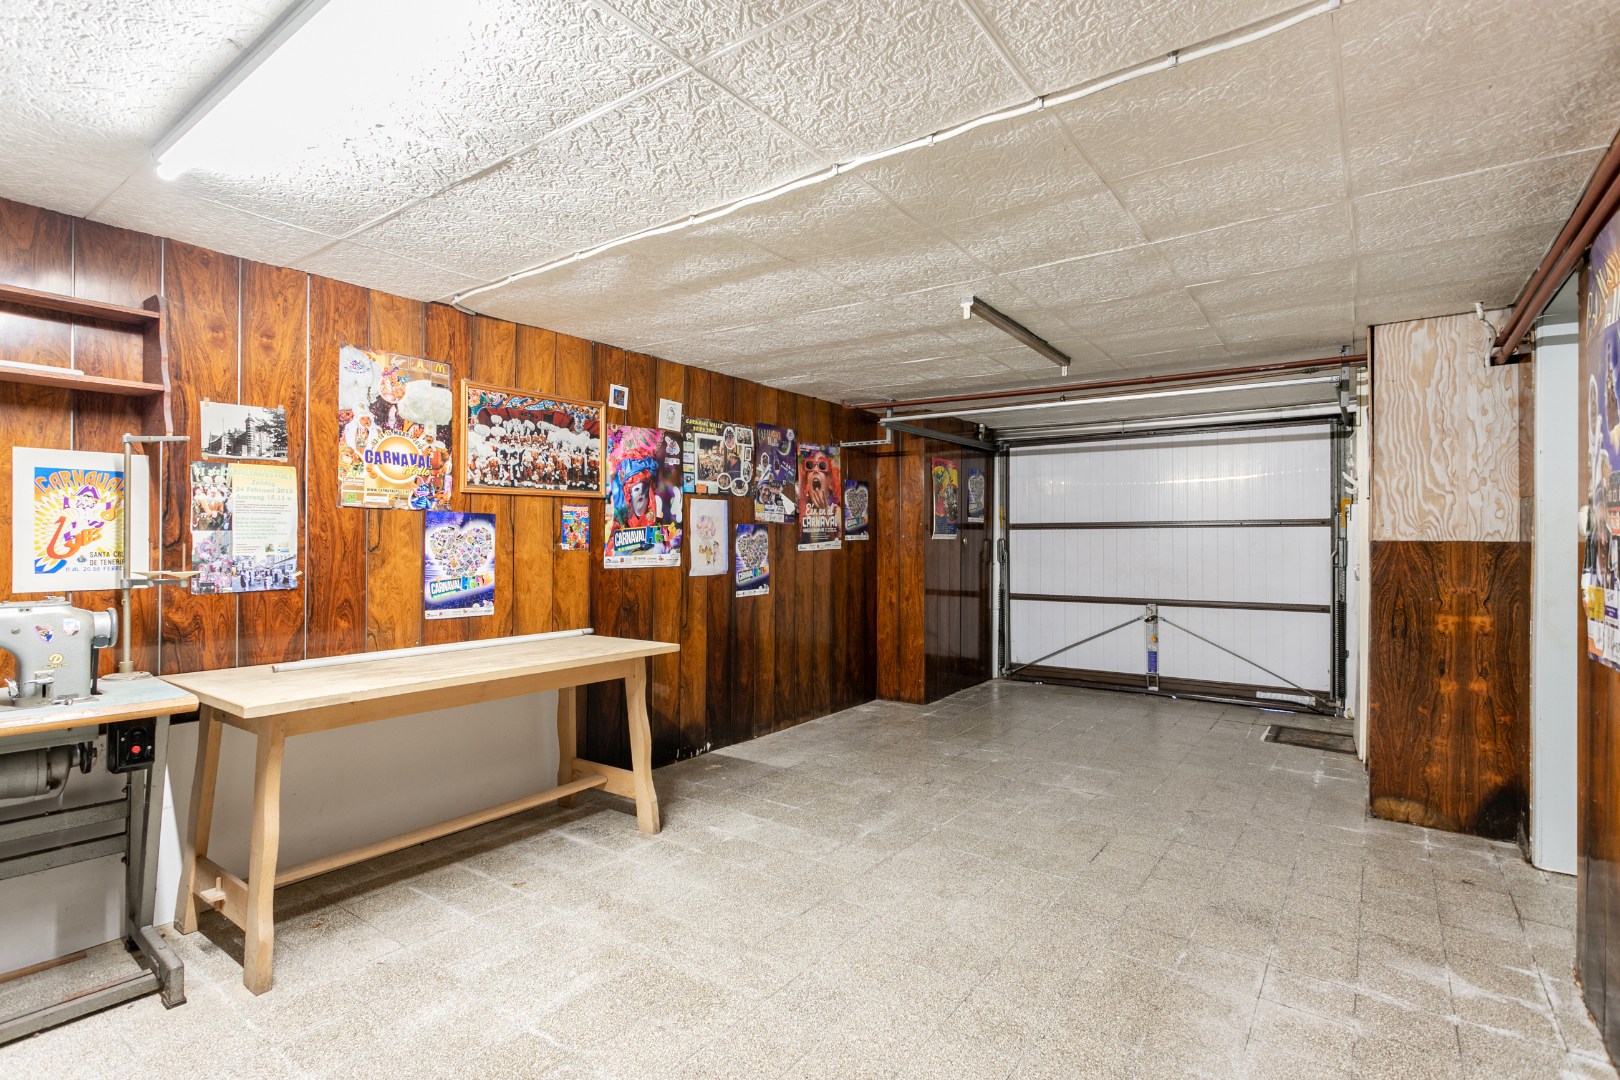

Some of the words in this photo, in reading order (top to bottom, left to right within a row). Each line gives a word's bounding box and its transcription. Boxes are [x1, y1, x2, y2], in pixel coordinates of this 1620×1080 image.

[365, 449, 432, 469] CARNAVAL
[802, 515, 838, 528] CARNAVAL
[614, 529, 646, 547] CARNAVAL
[113, 550, 125, 558] CRU
[100, 558, 125, 566] TENERIF
[430, 579, 460, 595] CARNAVAL
